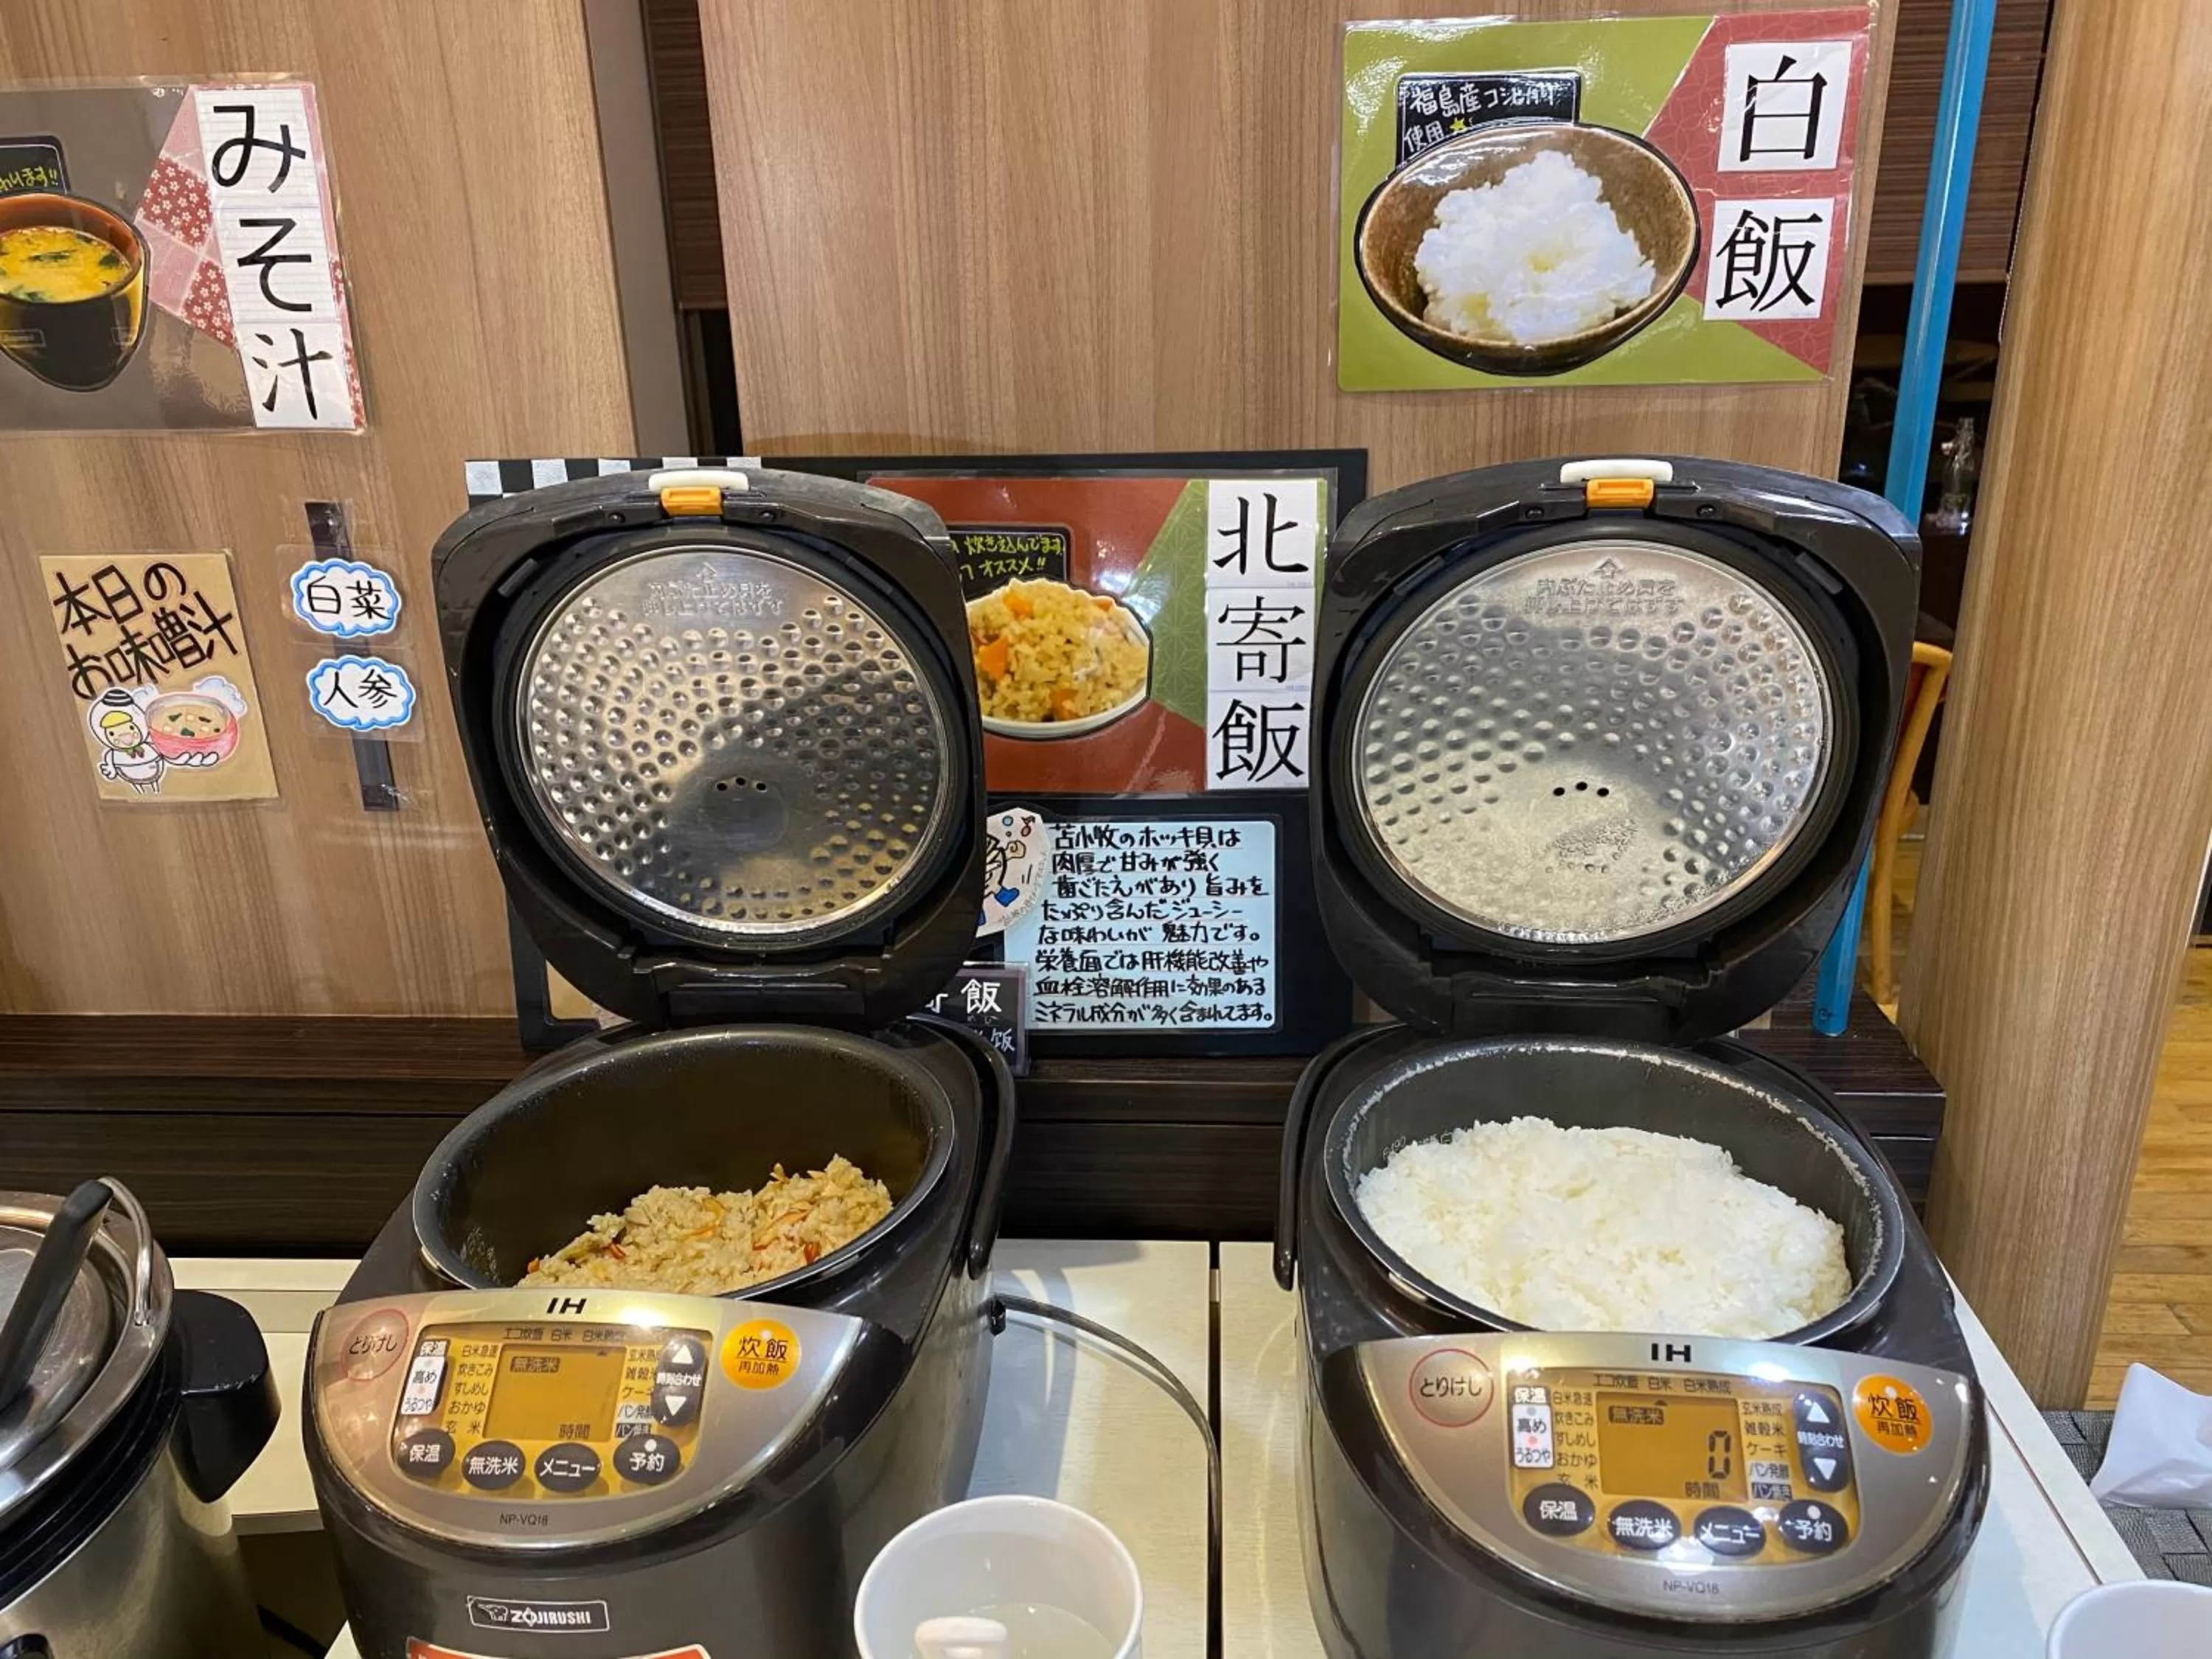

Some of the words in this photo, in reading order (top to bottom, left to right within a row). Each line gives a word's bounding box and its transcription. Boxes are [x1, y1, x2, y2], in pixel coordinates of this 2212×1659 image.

[1403, 119, 1444, 153] 使用
[1716, 55, 1828, 313] 白飯
[211, 104, 334, 420] みそ汁
[52, 562, 187, 636] 本日の
[307, 575, 391, 620] 白菜
[1213, 492, 1310, 783] 北寄飯
[323, 669, 398, 709] 人参
[1049, 824, 1242, 849] 苫小牧のホッキ貝は
[1052, 849, 1219, 876] 肉厚で甘みが強く
[1041, 897, 1244, 921] たっぷり含んだジューシー
[1038, 921, 1260, 945] な味わいが魅力です。
[1034, 946, 1269, 975] 栄養面では肝機能改善や
[1033, 973, 1266, 998] 血栓溶解作用に効果のある
[546, 1298, 588, 1315] IH
[349, 1333, 398, 1354] とりけし
[737, 1335, 789, 1361] 炊飯
[1651, 1343, 1692, 1363] IH
[453, 1382, 490, 1397] すしめし
[1420, 1376, 1483, 1399] とりけし
[1648, 1377, 1672, 1391] 白米
[448, 1401, 487, 1416] おかゆ
[1868, 1393, 1920, 1421] 炊飯
[1517, 1417, 1547, 1434] 高め
[1554, 1411, 1594, 1427] 炊きこみ
[1555, 1432, 1596, 1447] すしめし
[1745, 1441, 1789, 1458] ケーキ
[409, 1444, 441, 1462] 保温
[629, 1453, 665, 1472] 予約
[1515, 1447, 1551, 1464] うるつや
[1557, 1452, 1598, 1468] おかゆ
[1708, 1430, 1731, 1480] 0
[467, 1455, 519, 1475] 無洗米
[539, 1458, 597, 1478] メニュー
[1685, 1481, 1721, 1500] 時間
[1539, 1500, 1579, 1522] 保温
[1614, 1516, 1673, 1539] 無洗米
[1699, 1522, 1761, 1544] メニュー
[1794, 1520, 1834, 1542] 予約
[1662, 1579, 1720, 1595] NP-VQ18
[509, 1607, 591, 1627] ZOJIRUSHI
